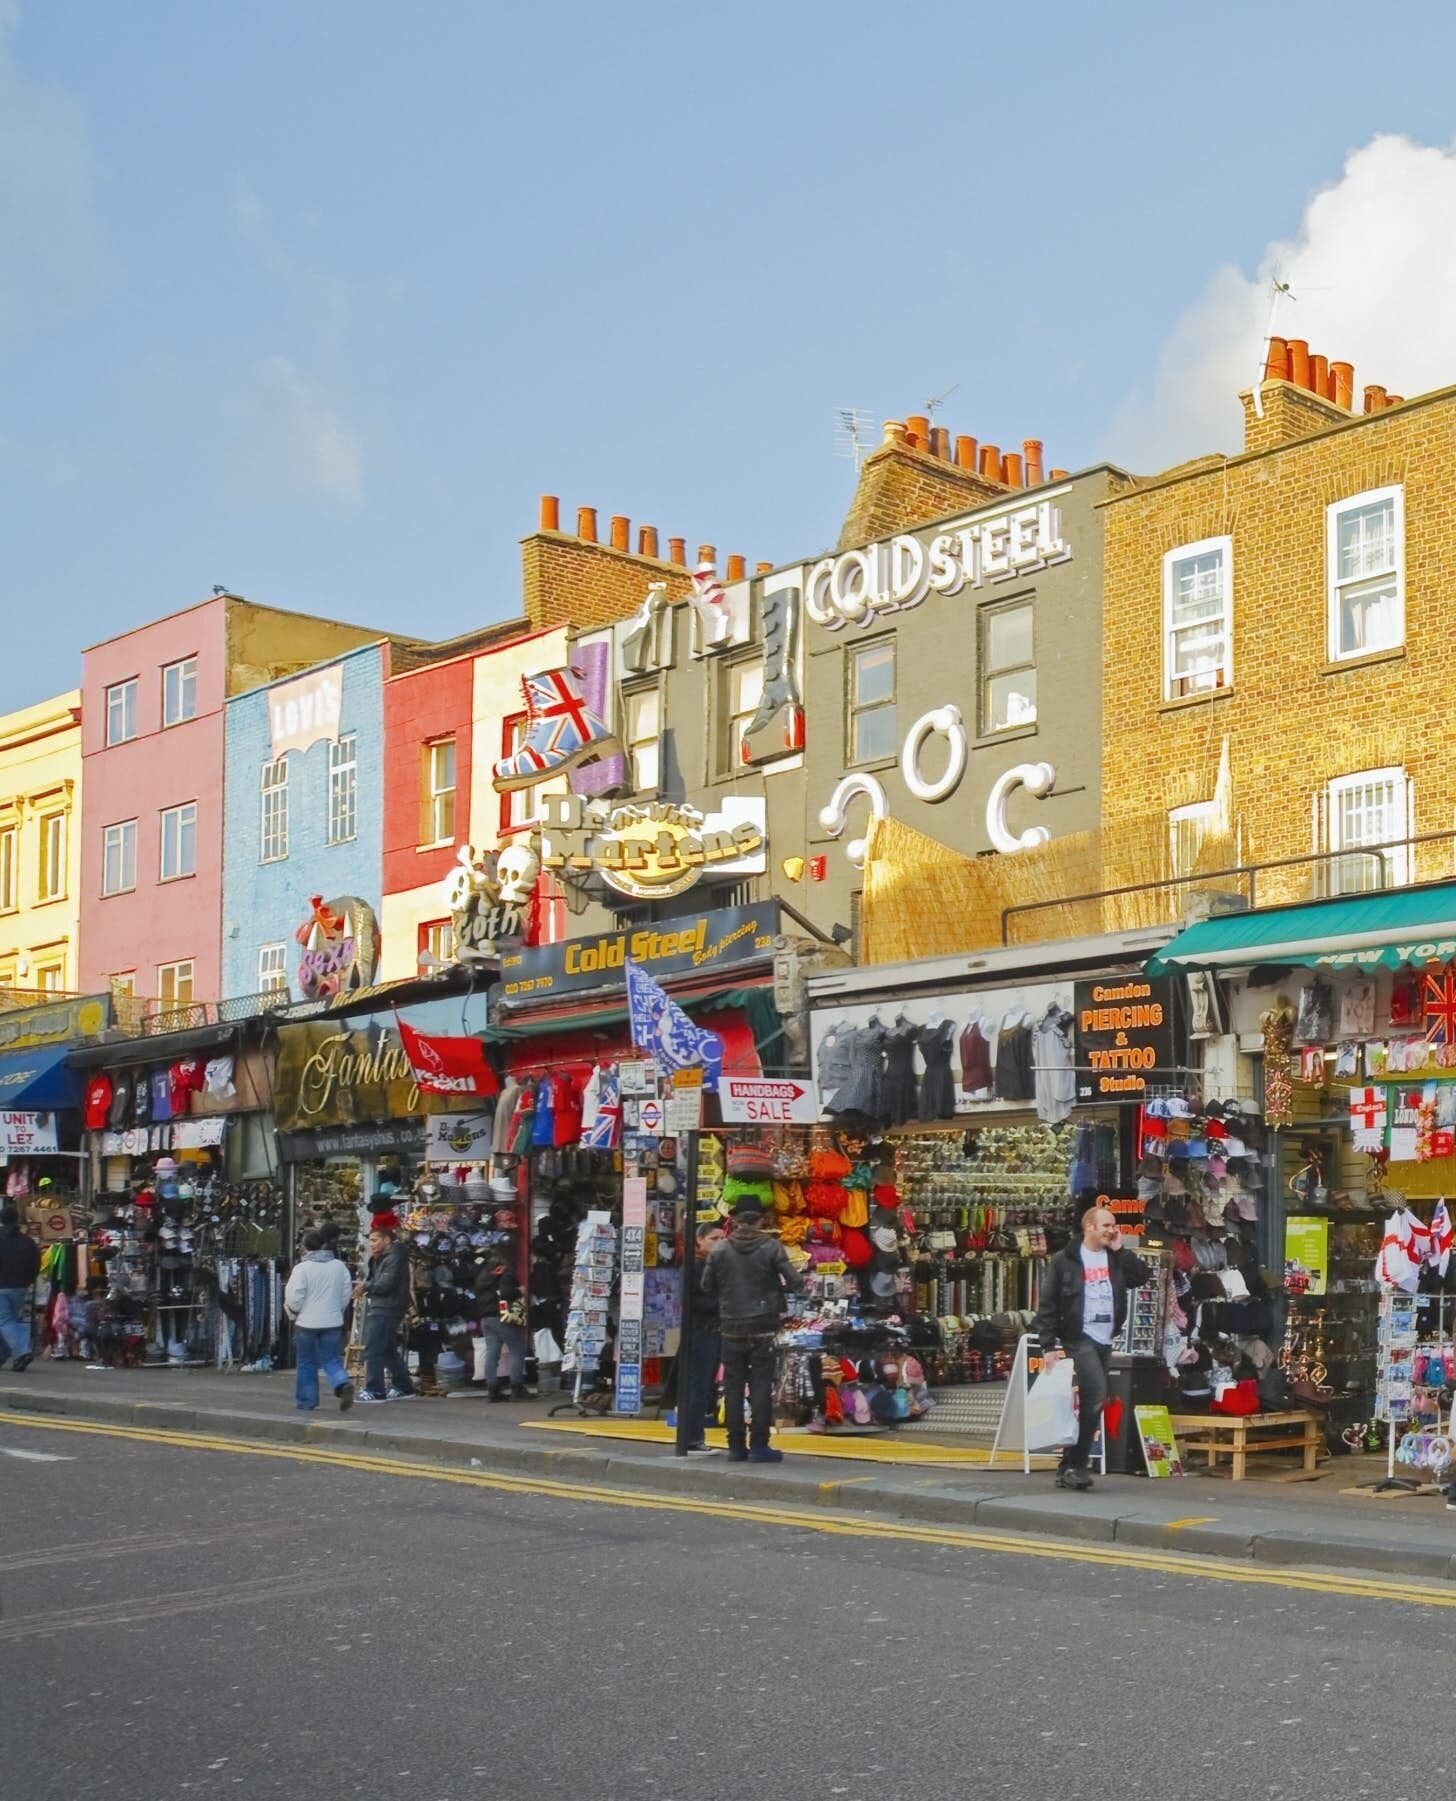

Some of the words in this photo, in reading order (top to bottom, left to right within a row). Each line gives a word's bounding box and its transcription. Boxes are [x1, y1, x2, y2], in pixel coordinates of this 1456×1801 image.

[806, 534, 924, 626] COLD
[928, 500, 1064, 590] STEEL
[541, 822, 763, 870] Martens
[456, 902, 521, 944] Goth
[565, 938, 625, 975] Cold
[631, 918, 709, 963] Steel
[1314, 949, 1385, 965] NEW
[1093, 983, 1151, 1002] Camden
[1081, 1003, 1163, 1032] PIERCING
[1115, 1032, 1128, 1046] &
[1088, 1046, 1156, 1072] TATTOO
[733, 1083, 795, 1097] HANDBAGS
[1099, 1075, 1146, 1092] Studio
[1399, 1092, 1407, 1109] I
[3, 1113, 35, 1125] UNIT
[747, 1101, 793, 1120] SALE
[1394, 1107, 1420, 1125] LONDO
[15, 1125, 26, 1133] TO
[8, 1133, 35, 1145] LET
